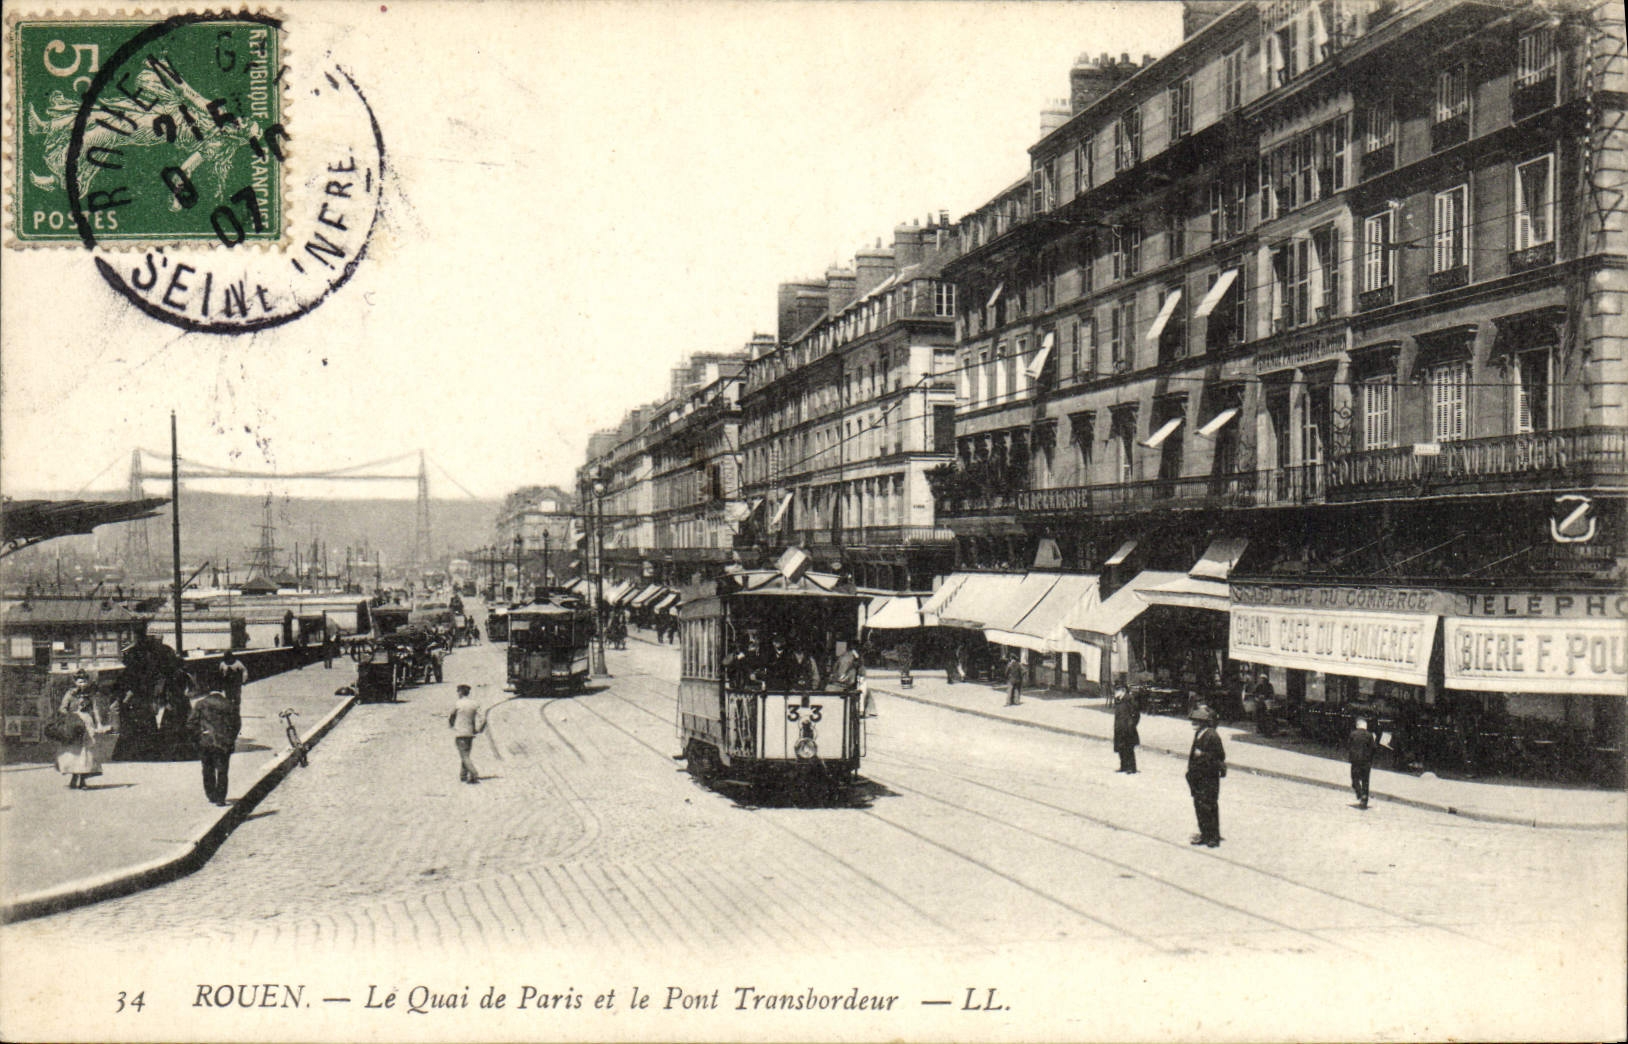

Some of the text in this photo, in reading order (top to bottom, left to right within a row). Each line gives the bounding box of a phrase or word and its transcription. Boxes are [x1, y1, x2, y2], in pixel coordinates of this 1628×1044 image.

[1319, 588, 1337, 605] DU
[1346, 588, 1428, 610] COMMERCE
[1315, 621, 1335, 655] DU
[1341, 623, 1418, 664] COMMERCE
